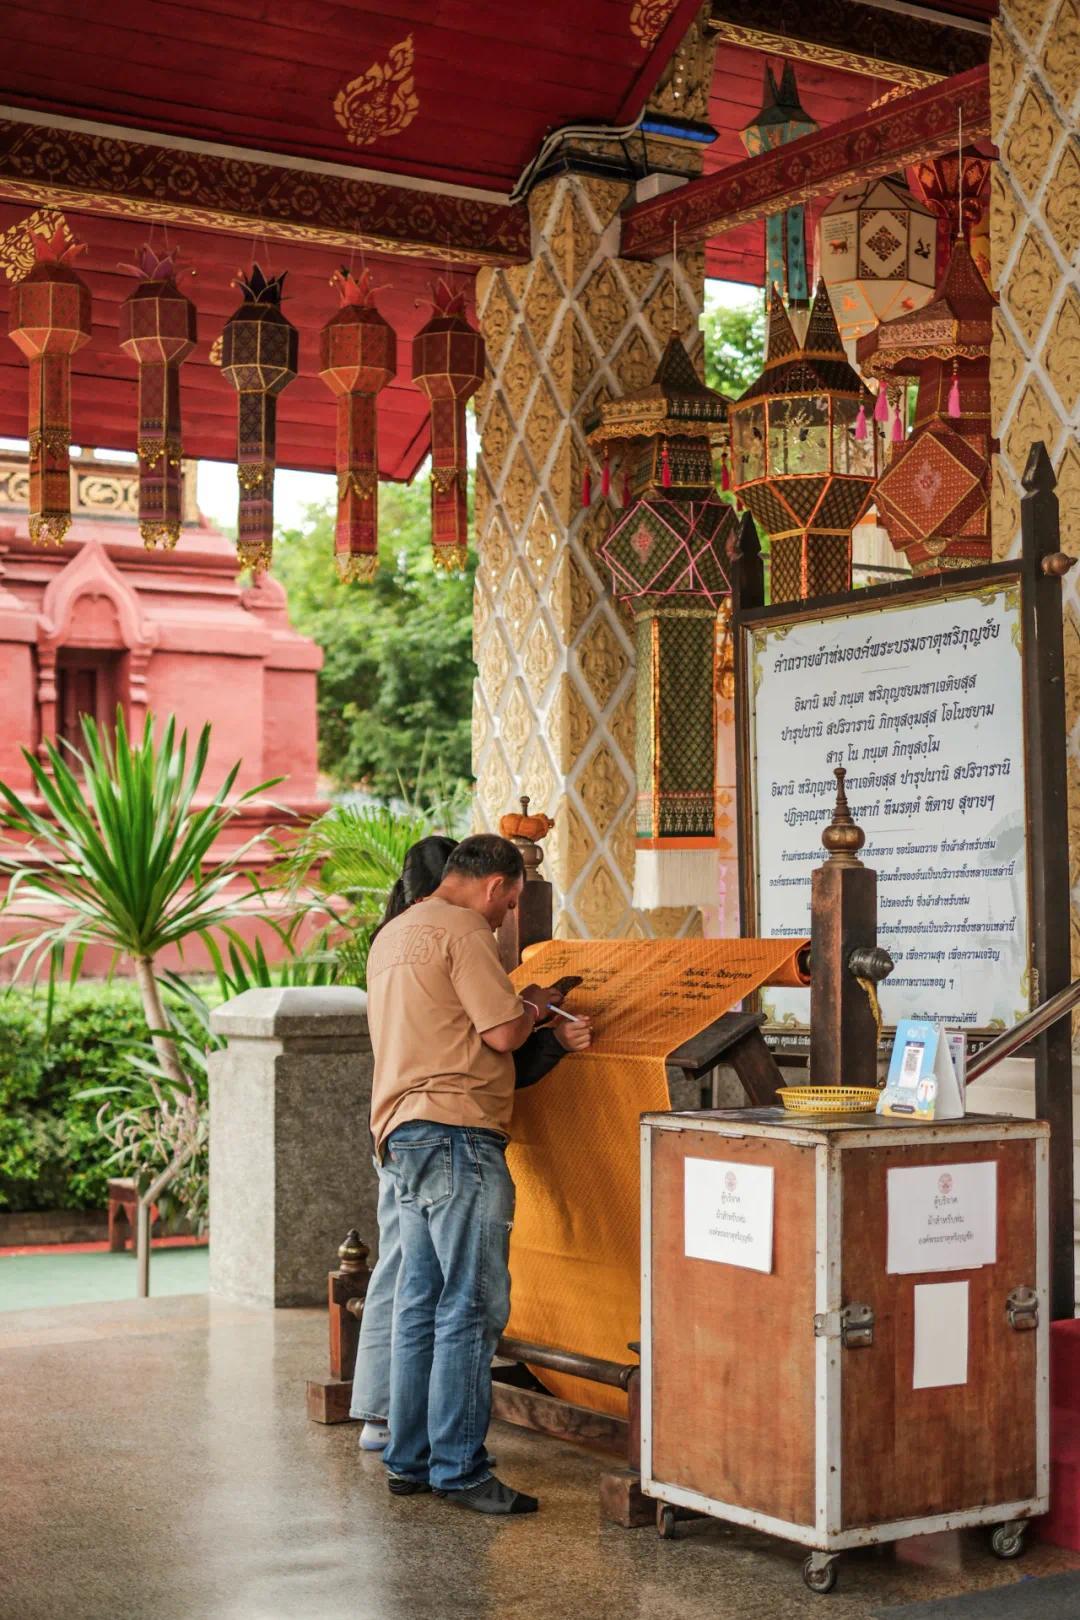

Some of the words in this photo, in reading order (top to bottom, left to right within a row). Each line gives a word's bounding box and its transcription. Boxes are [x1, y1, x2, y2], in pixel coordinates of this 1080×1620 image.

[794, 694, 820, 712] อิมานิ
[781, 721, 823, 744] ปารุปนานิ
[826, 714, 875, 736] สปริวารานิ
[848, 743, 858, 761] โน
[771, 780, 796, 797] อิมานิ
[900, 765, 950, 789] ปารุปนานิ
[954, 758, 1011, 780] สปริวารานิ
[924, 796, 955, 812] หิตาย
